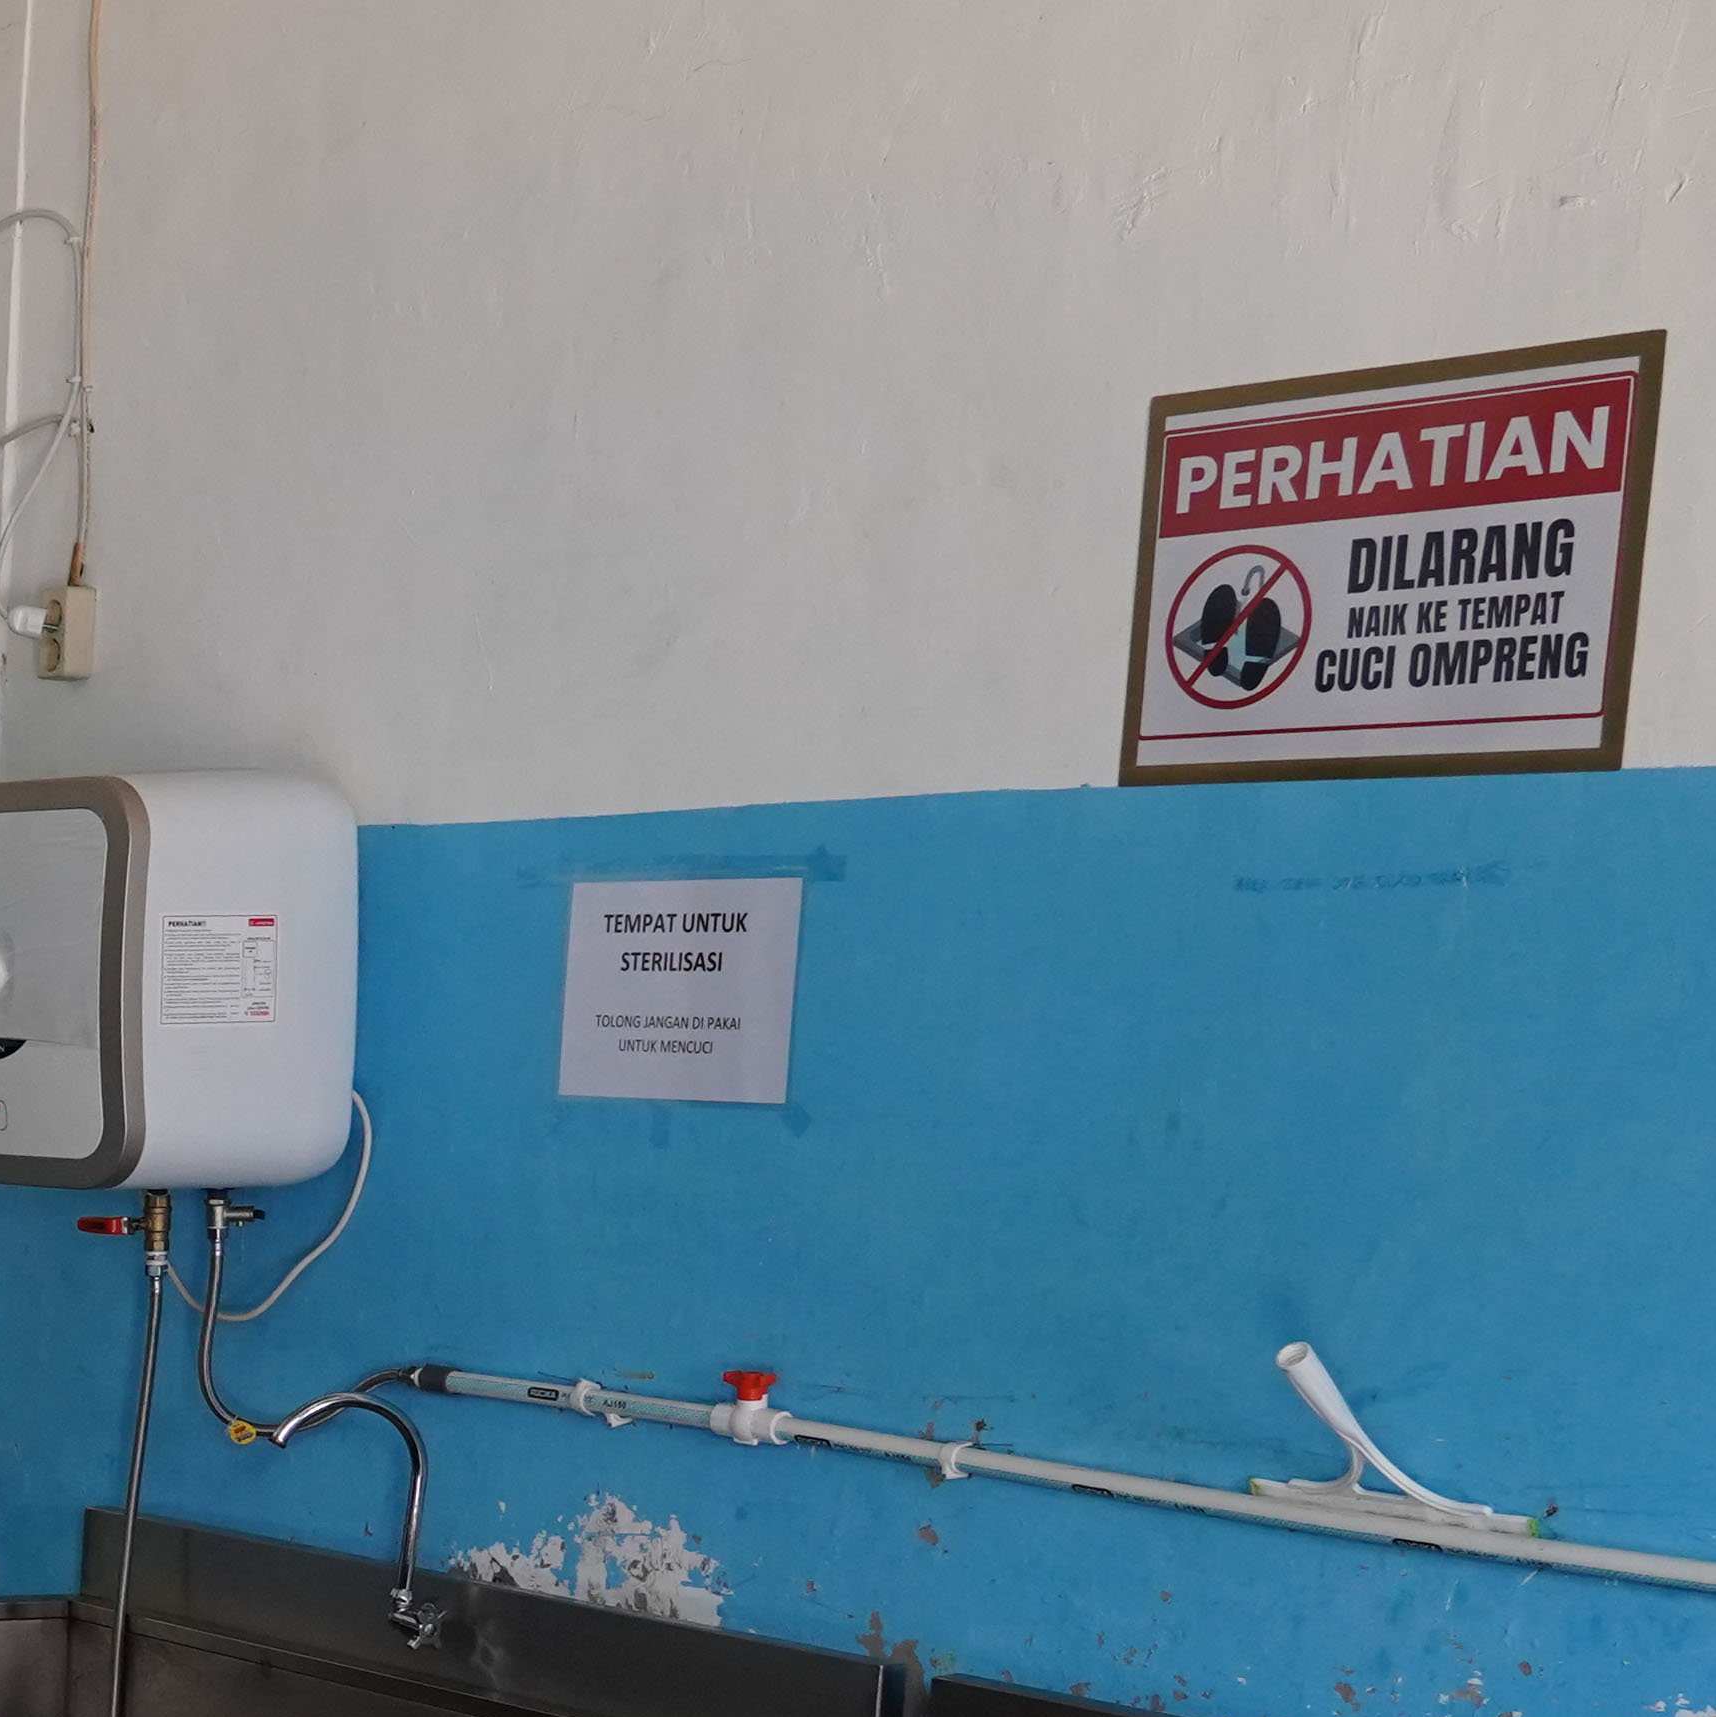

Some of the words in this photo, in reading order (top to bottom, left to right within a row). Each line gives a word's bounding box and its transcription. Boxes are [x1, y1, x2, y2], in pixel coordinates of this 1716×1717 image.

[1174, 404, 1611, 515] PERHATIAN
[1346, 517, 1576, 595] DILARANG
[1346, 602, 1408, 639] NAIK
[1416, 600, 1448, 634] KE
[1457, 590, 1566, 631] TEMPAT
[1314, 644, 1397, 694] CUCI
[1407, 631, 1590, 688] OMPRENG
[603, 912, 678, 934] TEMPAT
[681, 911, 749, 934] UNTUK
[620, 951, 723, 972] STERILISASI
[595, 1014, 641, 1029] TOLONG
[643, 1015, 689, 1030] JANGAN
[692, 1016, 705, 1030] DI
[707, 1016, 742, 1031] PAKAI
[618, 1039, 658, 1053] UNTUK
[659, 1040, 714, 1054] MENCUCI
